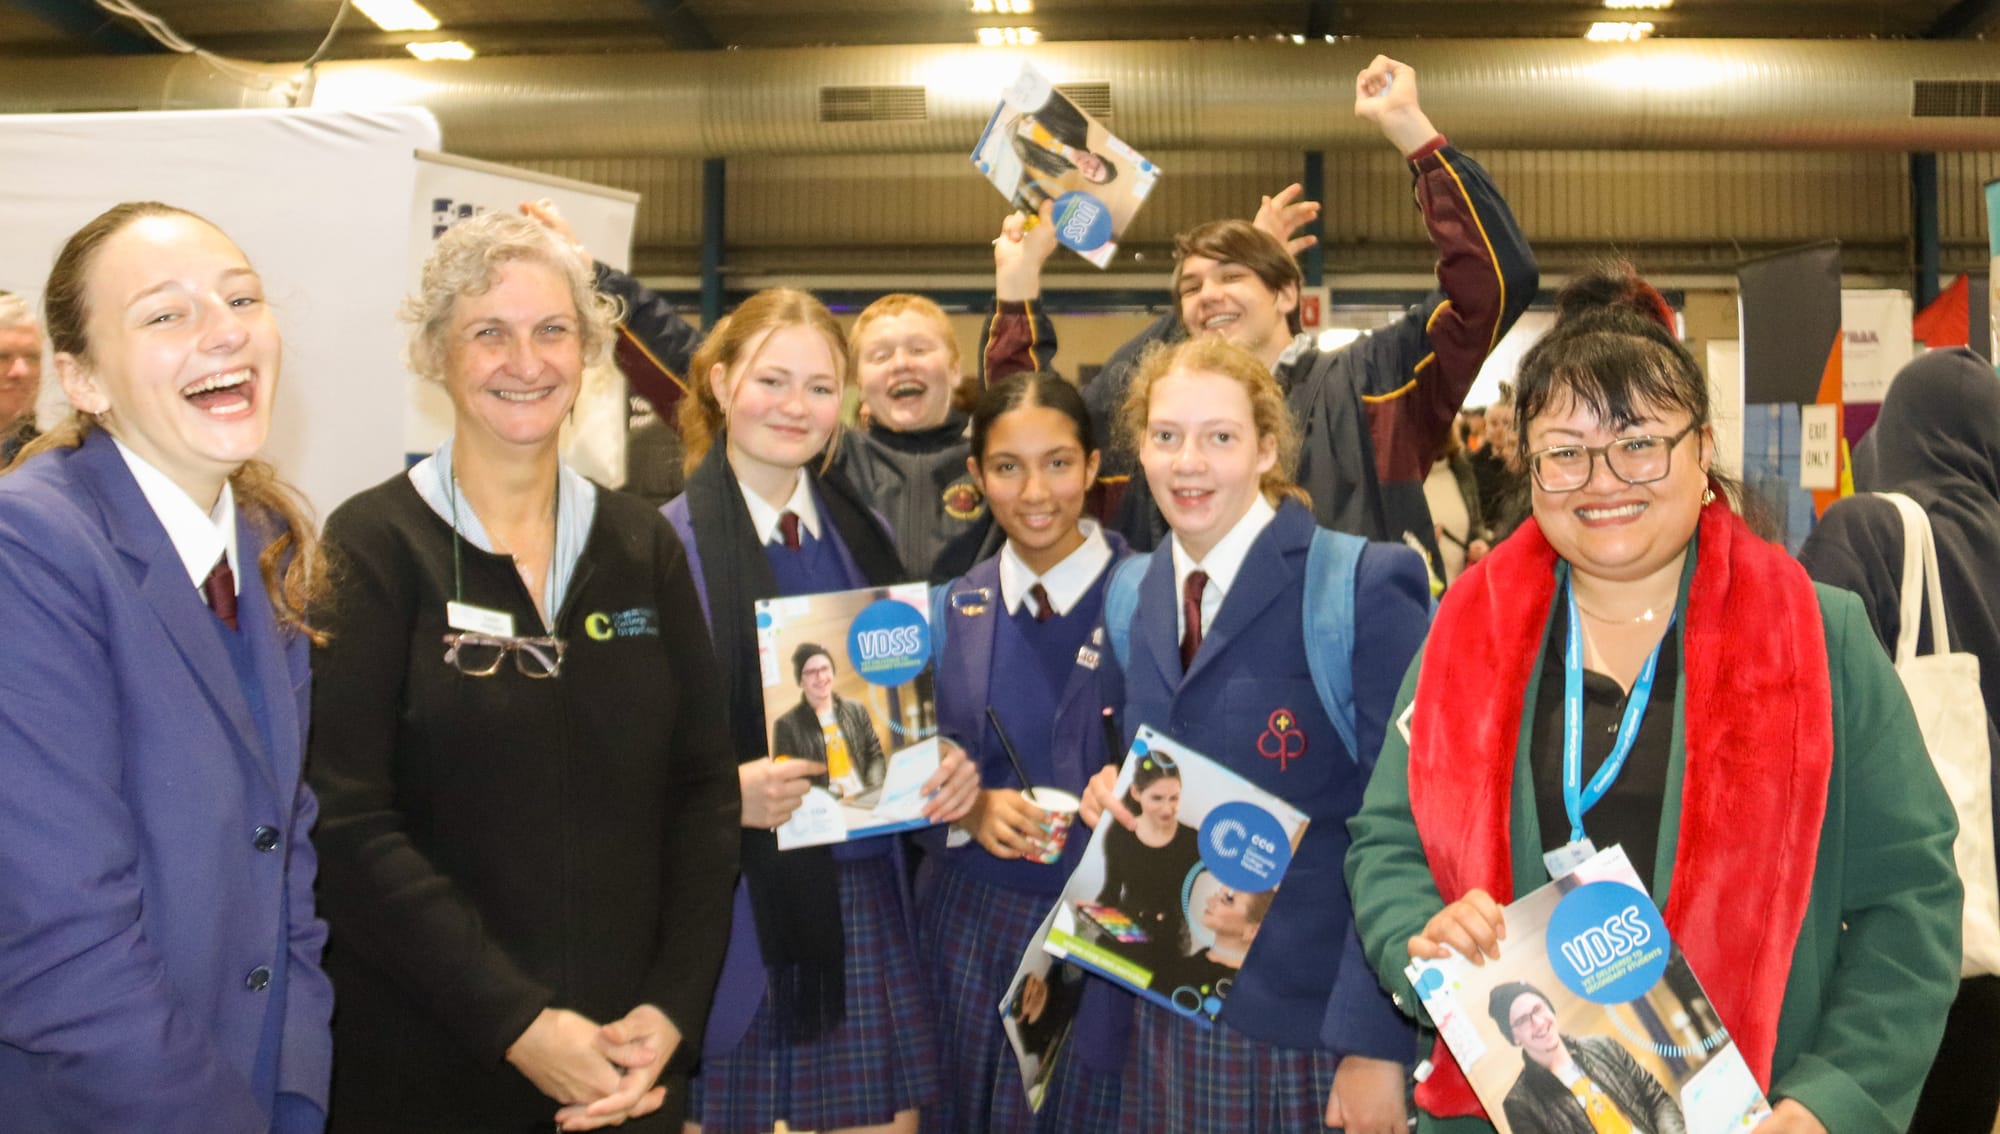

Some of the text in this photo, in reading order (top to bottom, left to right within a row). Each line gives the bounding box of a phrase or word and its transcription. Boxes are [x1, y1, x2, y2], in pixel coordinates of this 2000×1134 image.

[1808, 423, 1827, 440] EXIT
[1806, 450, 1829, 467] ONLY
[857, 625, 920, 659] VDSS
[1561, 905, 1651, 977] VDSS
[1581, 949, 1643, 987] VET DELIVERED TO
[1627, 947, 1663, 971] STUDENTS
